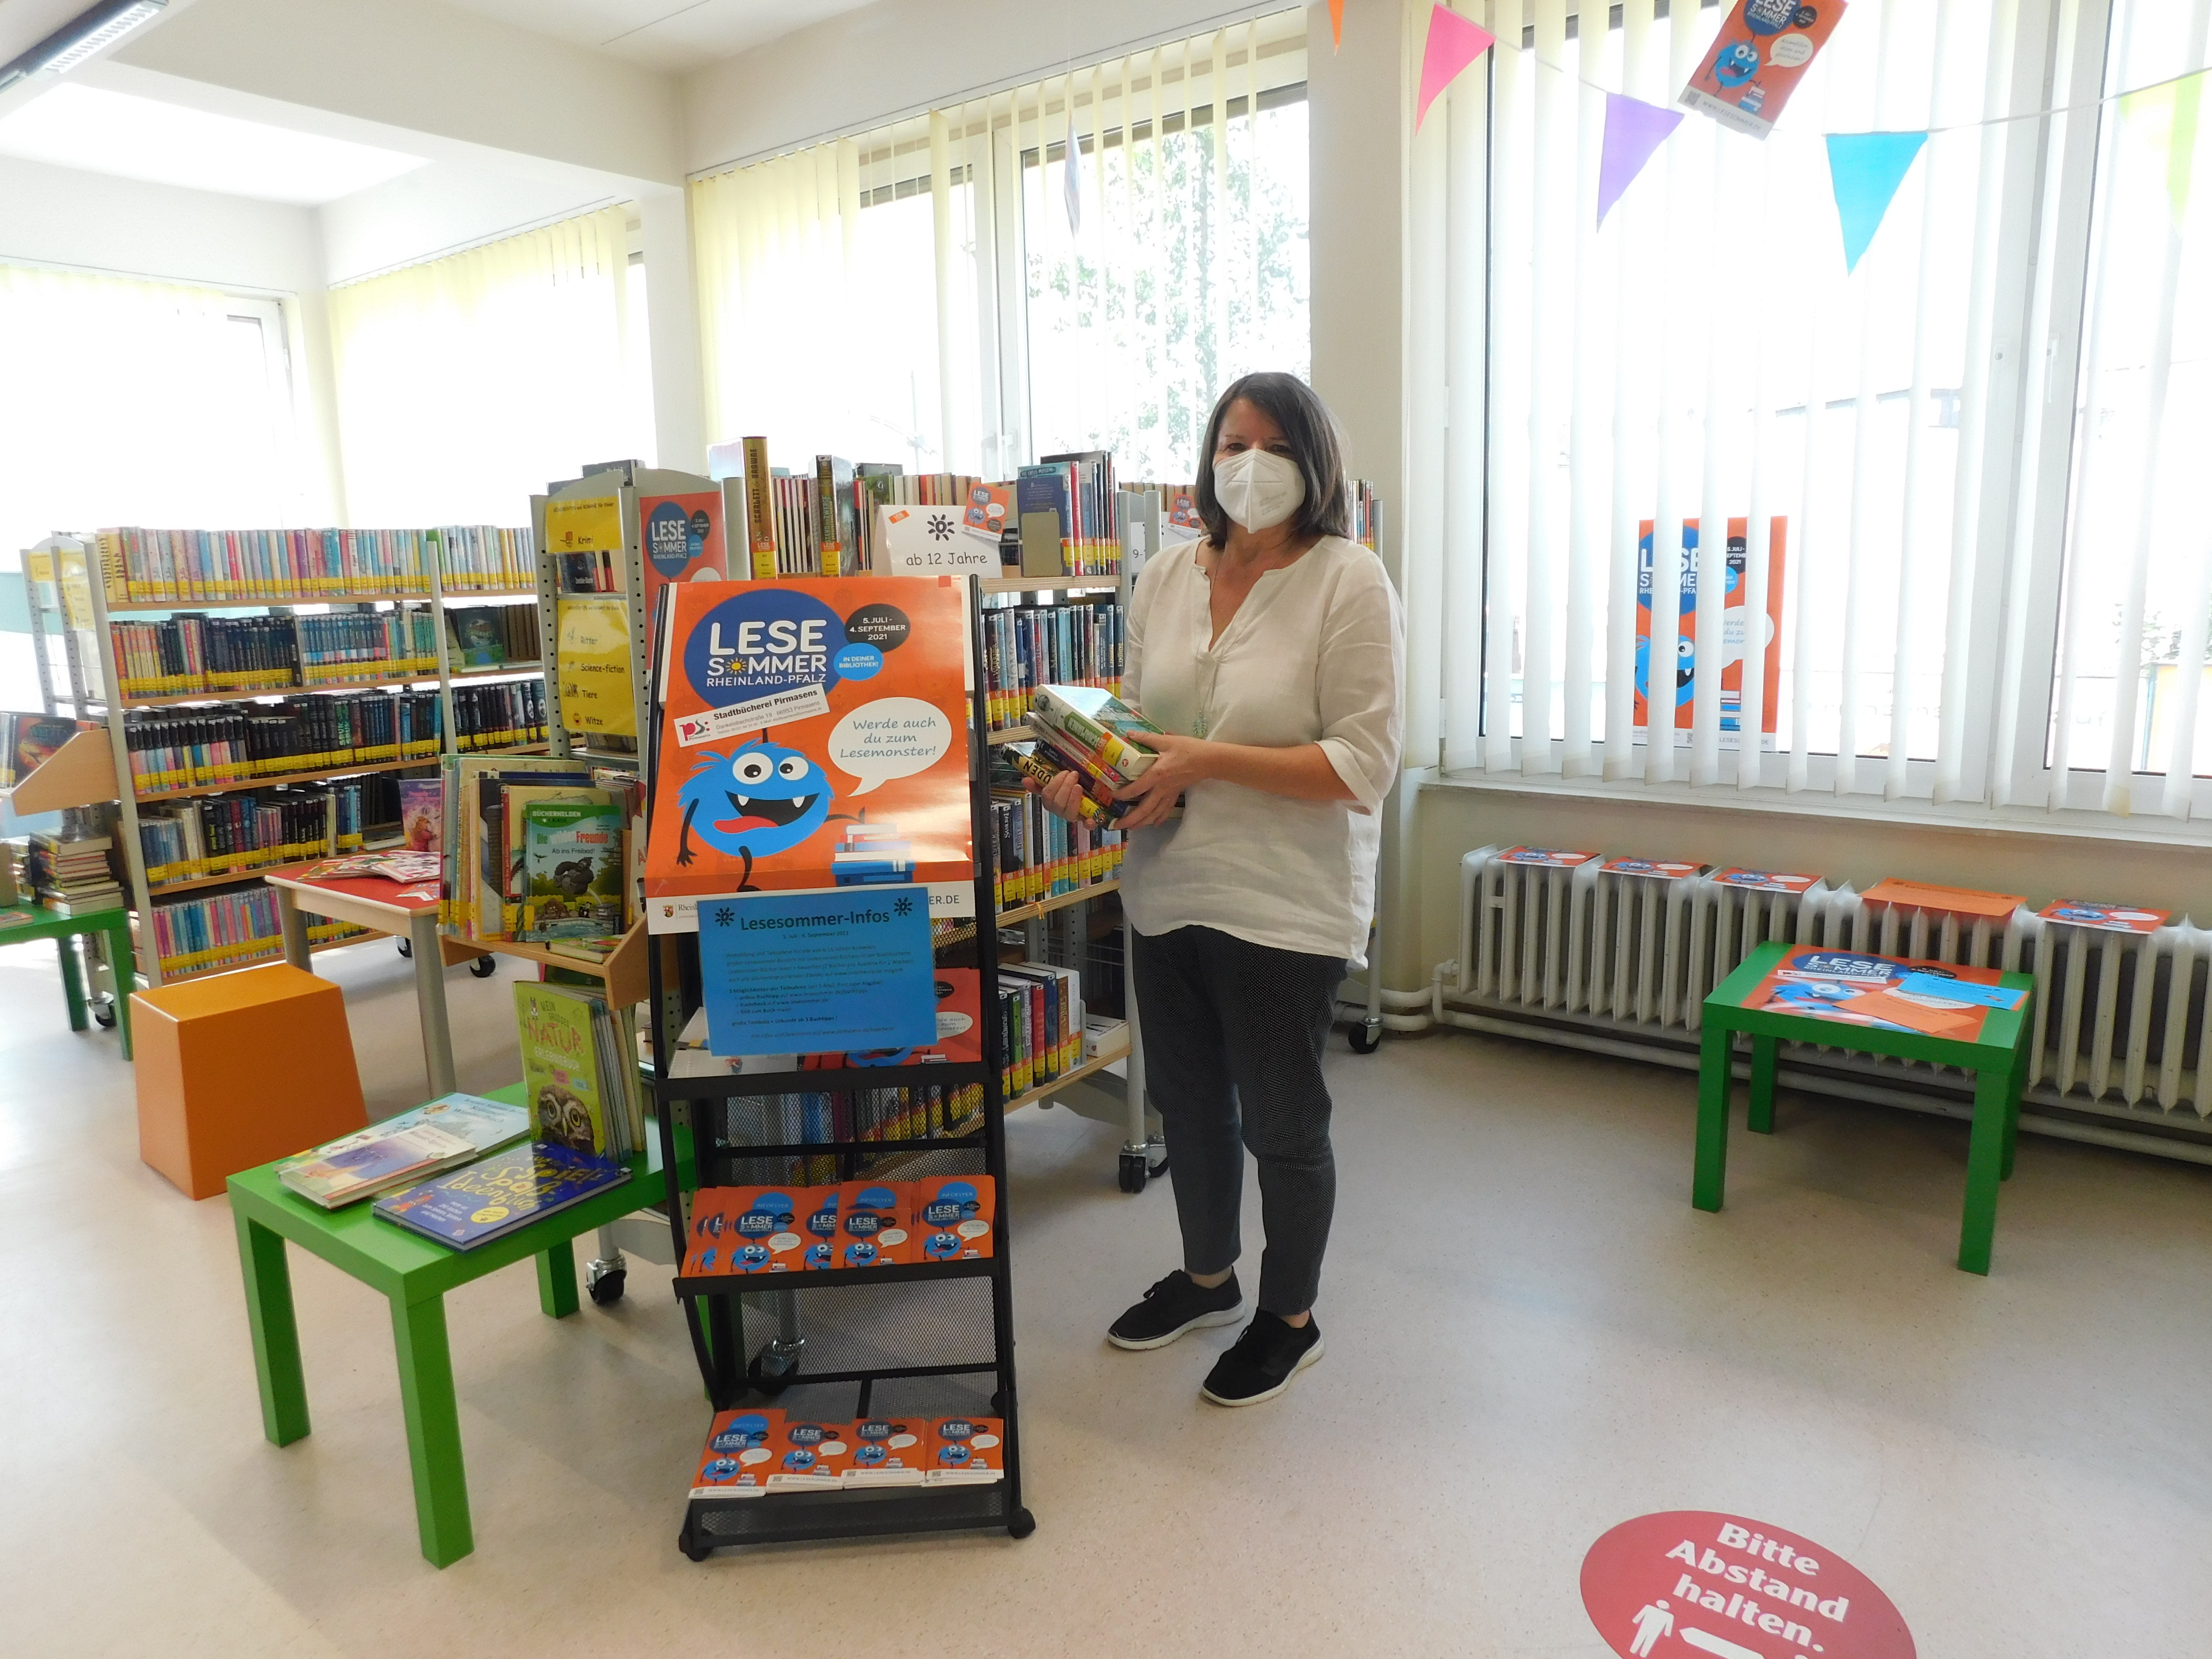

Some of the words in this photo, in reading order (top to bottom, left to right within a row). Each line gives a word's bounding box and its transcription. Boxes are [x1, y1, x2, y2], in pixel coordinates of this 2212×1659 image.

[754, 488, 762, 523] SCARLETT
[651, 520, 686, 541] LESE
[578, 535, 594, 545] Krimi
[653, 541, 687, 553] SOMMER
[1133, 549, 1143, 558] 9-
[906, 553, 922, 566] ab
[928, 553, 942, 565] 12
[948, 552, 987, 565] Jahre
[858, 625, 906, 633] SEPTEMBER
[580, 635, 598, 645] Ritter
[709, 619, 827, 655] LESE
[581, 663, 625, 674] Science-fiction
[707, 654, 827, 676] SOMMER
[707, 673, 827, 687] RHEINLAND-PFALZ
[582, 690, 598, 699] Tiere
[714, 700, 772, 720] Stadtbücherei
[774, 689, 818, 706] Pirmasens
[793, 701, 820, 711] Pirmasens
[585, 716, 603, 726] Witze
[853, 718, 903, 731] Werde
[905, 716, 936, 730] auch
[864, 732, 882, 744] du
[885, 733, 917, 744] zum
[840, 745, 936, 758] Lesemonster!
[1023, 760, 1053, 783] UDEN
[537, 833, 548, 844] Die
[577, 831, 609, 844] Freunde
[928, 894, 960, 906] ER.DE
[741, 909, 890, 931] Lesesommer-Infos
[1810, 955, 1896, 971] LESE
[527, 1017, 586, 1057] NATUR
[928, 1205, 960, 1214] LESE
[741, 1215, 773, 1225] LESE
[812, 1214, 837, 1224] LES
[716, 1434, 748, 1443] LESE
[1717, 1522, 1820, 1576] Bitte
[1665, 1539, 1851, 1623] Abstand
[1672, 1574, 1825, 1653] halten.
